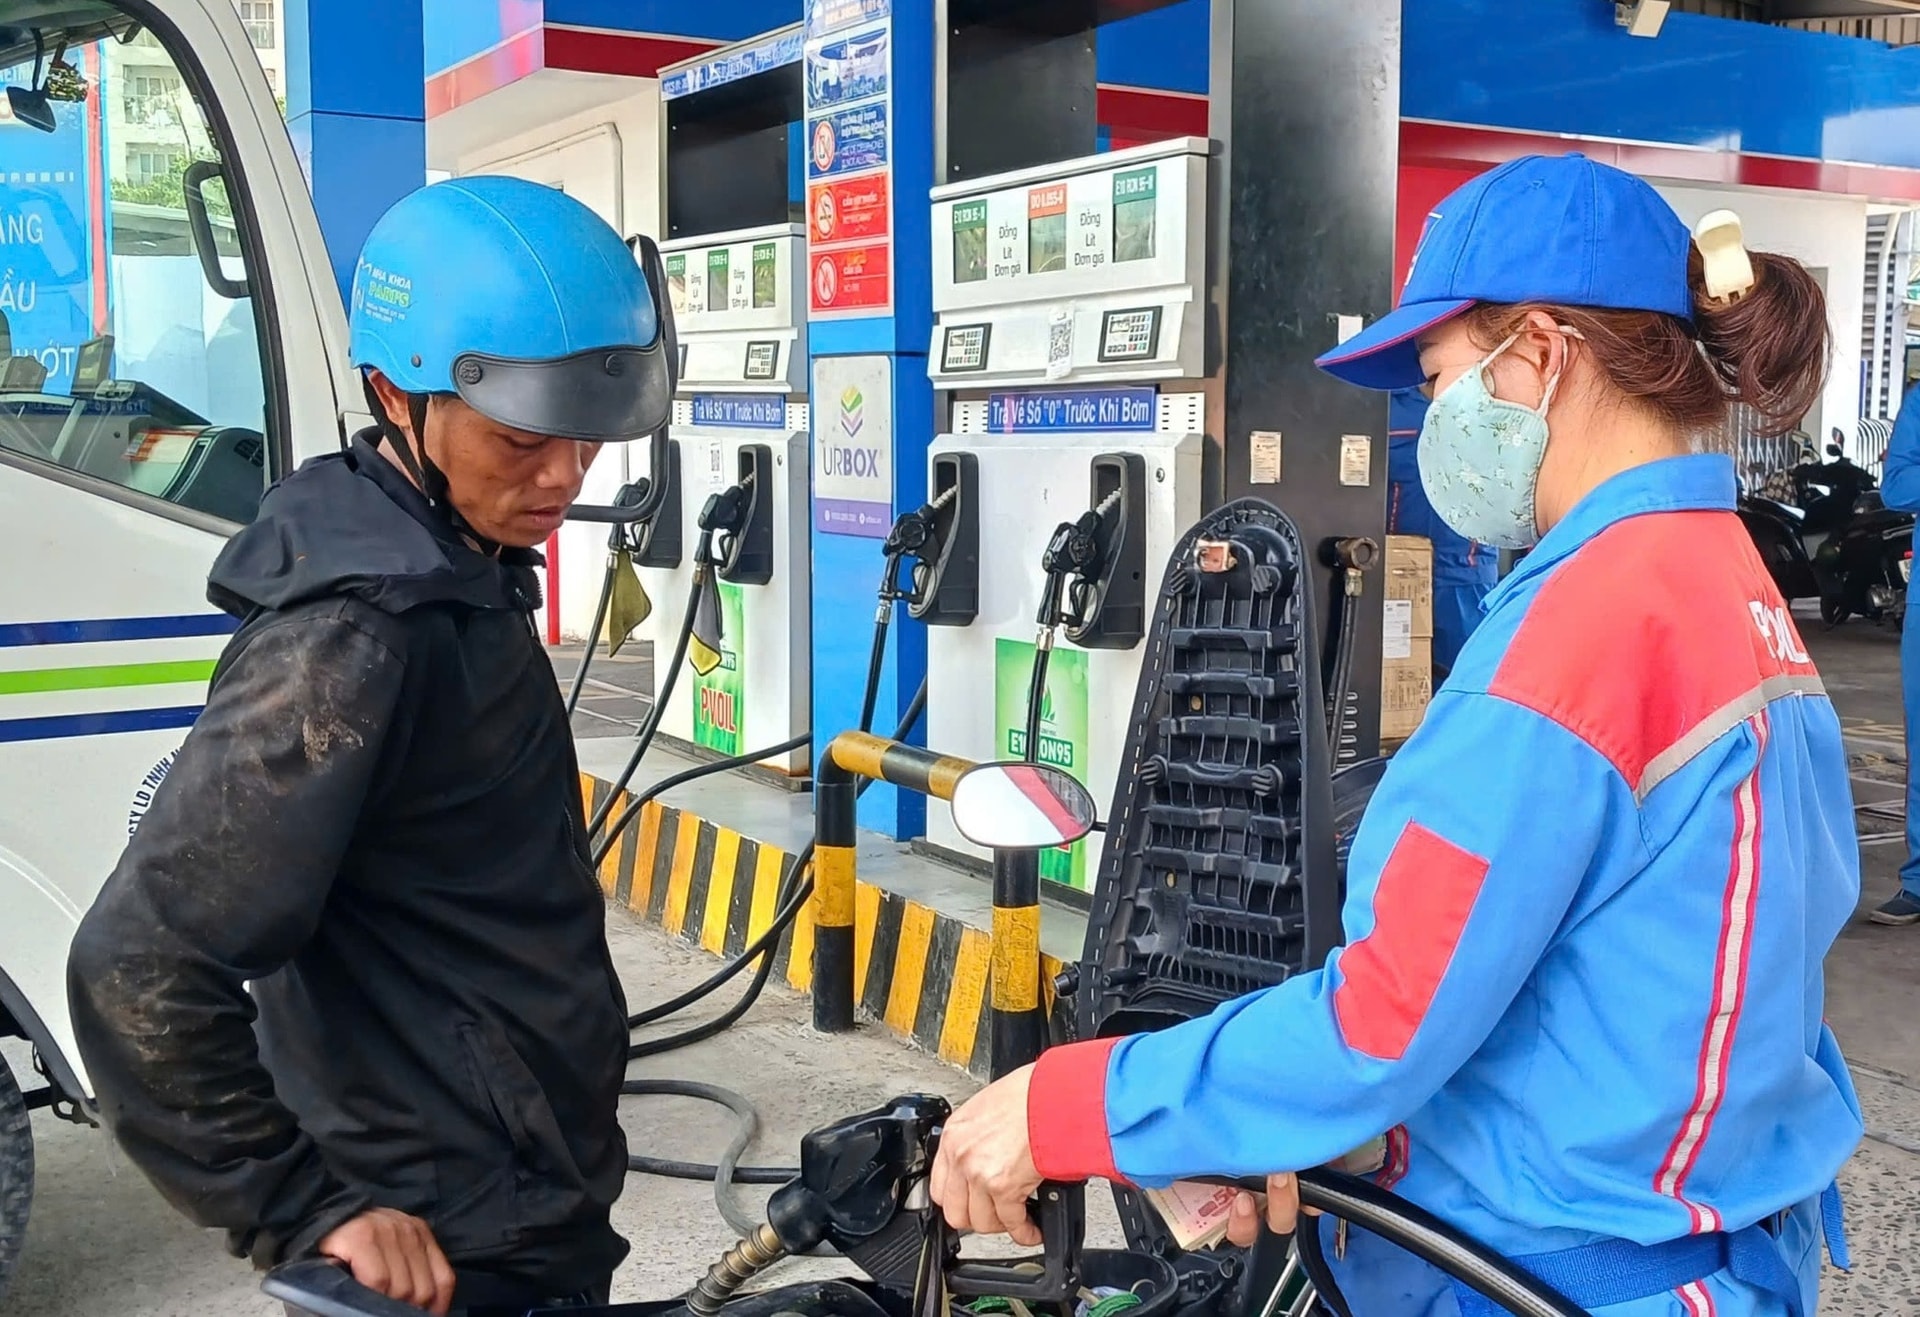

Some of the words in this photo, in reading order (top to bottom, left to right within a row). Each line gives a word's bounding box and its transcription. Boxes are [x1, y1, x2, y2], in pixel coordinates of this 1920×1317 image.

[15, 339, 76, 378] ỚT
[1027, 396, 1042, 424] Số
[1064, 399, 1096, 424] Trước
[1100, 398, 1118, 423] Khi
[1122, 397, 1149, 422] Bơm
[823, 447, 879, 478] URBOX
[701, 686, 736, 734] PVOIL
[133, 790, 151, 808] LD
[142, 757, 171, 790] TNHH
